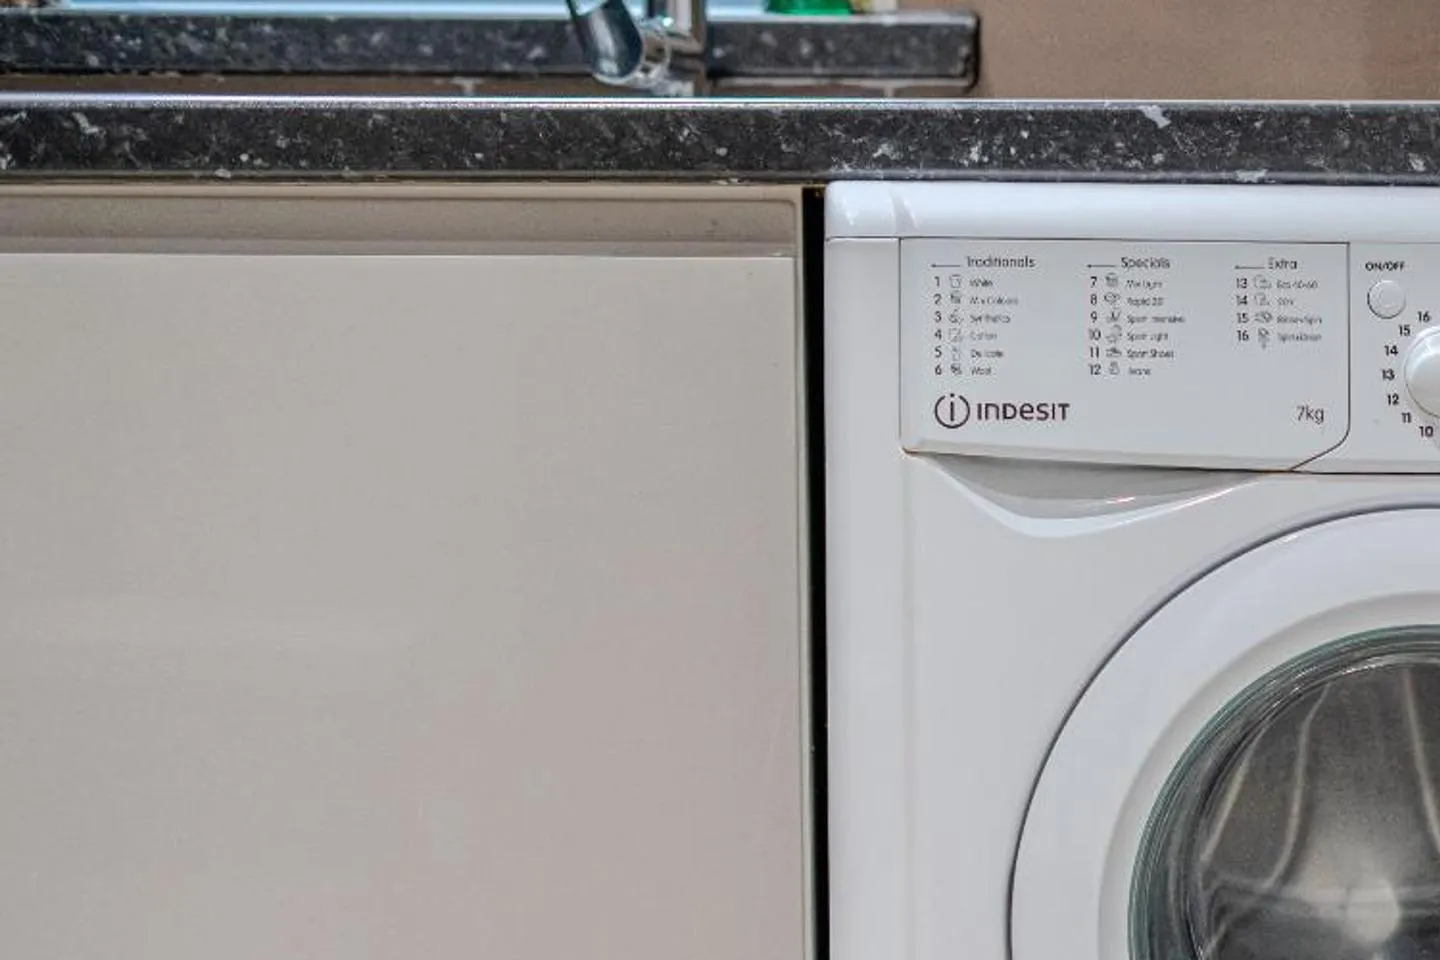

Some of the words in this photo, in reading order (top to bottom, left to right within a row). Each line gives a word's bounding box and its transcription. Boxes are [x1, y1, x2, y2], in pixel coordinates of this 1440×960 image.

[1121, 257, 1170, 270] Specials
[1268, 256, 1298, 270] Extra
[1365, 261, 1405, 271] ON/OFF
[934, 276, 941, 287] 1
[1090, 276, 1098, 288] 7
[1236, 277, 1247, 289] 13
[933, 293, 942, 305] 2
[1090, 293, 1098, 305] 8
[1236, 295, 1248, 305] 14
[934, 311, 942, 323] 3
[1090, 311, 1098, 323] 9
[1236, 312, 1249, 323] 15
[1418, 310, 1431, 323] 16
[934, 329, 942, 340] 4
[1089, 328, 1101, 340] 10
[1237, 330, 1249, 341] 16
[1399, 325, 1411, 336] 15
[934, 345, 942, 358] 5
[1090, 346, 1100, 358] 11
[1384, 345, 1398, 356] 14
[934, 364, 942, 376] 6
[1089, 363, 1101, 375] 12
[1382, 369, 1395, 380] 13
[1387, 394, 1399, 405] 12
[1297, 405, 1325, 424] 7kg
[1402, 412, 1411, 423] 11
[1419, 426, 1434, 438] 10
